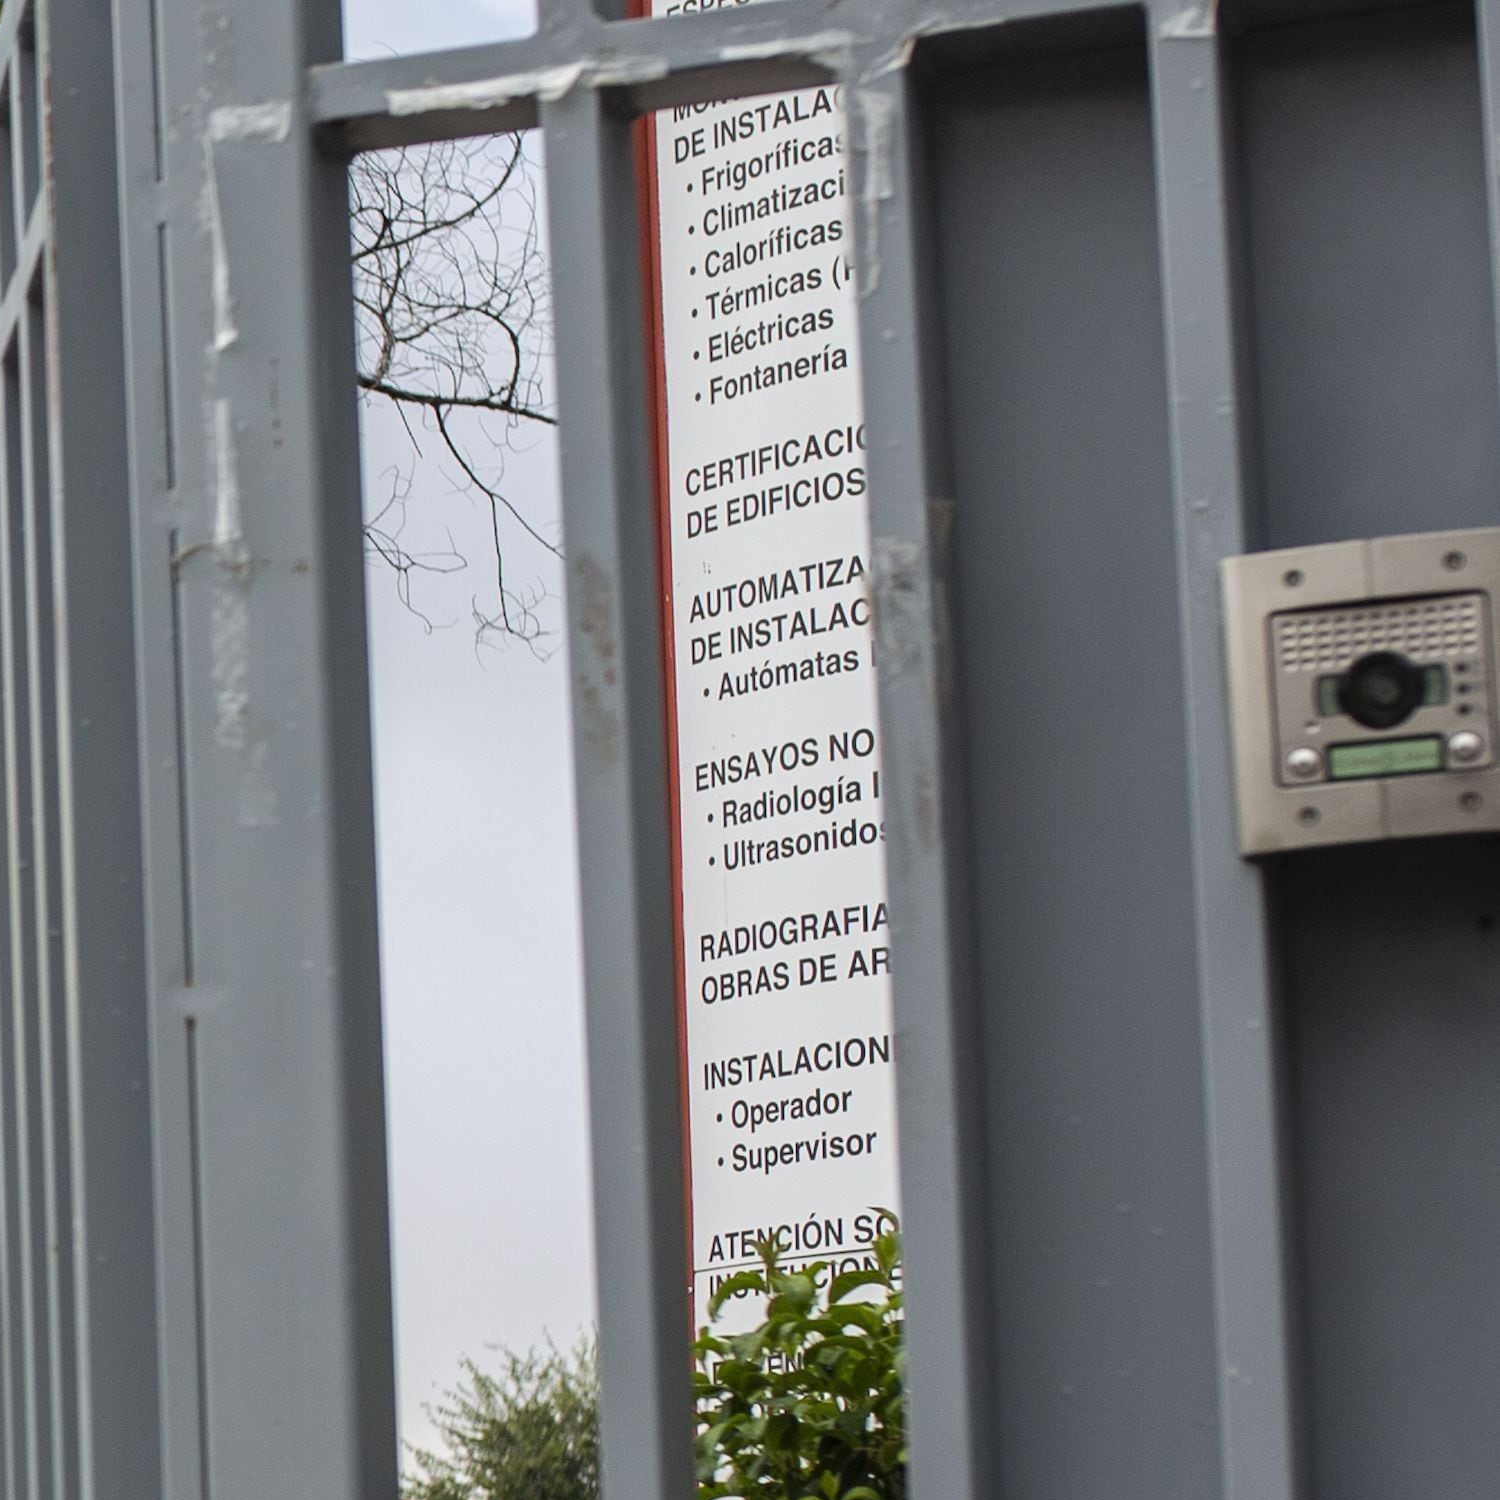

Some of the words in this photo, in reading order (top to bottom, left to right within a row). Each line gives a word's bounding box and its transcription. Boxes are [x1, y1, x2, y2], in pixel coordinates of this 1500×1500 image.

[674, 128, 706, 164] DE
[704, 219, 843, 278] Caloríficas
[706, 267, 822, 320] Térmicas
[708, 307, 834, 363] Eléctricas
[710, 346, 848, 404] Fontanería
[687, 506, 718, 538] DE
[726, 467, 866, 527] EDIFICIOS
[691, 632, 722, 665] DE
[730, 598, 871, 654] INSTALAC
[718, 648, 859, 701] Autómatas
[695, 738, 819, 792] ENSAYOS
[829, 728, 875, 762] NO
[722, 775, 862, 828] Radiología
[702, 962, 790, 1004] OBRAS
[800, 954, 838, 986] DE
[704, 1035, 896, 1091] INSTALACION
[731, 1087, 853, 1134] Operador
[732, 1129, 877, 1175] Supervisor
[709, 1213, 843, 1263] ATENCIÓN
